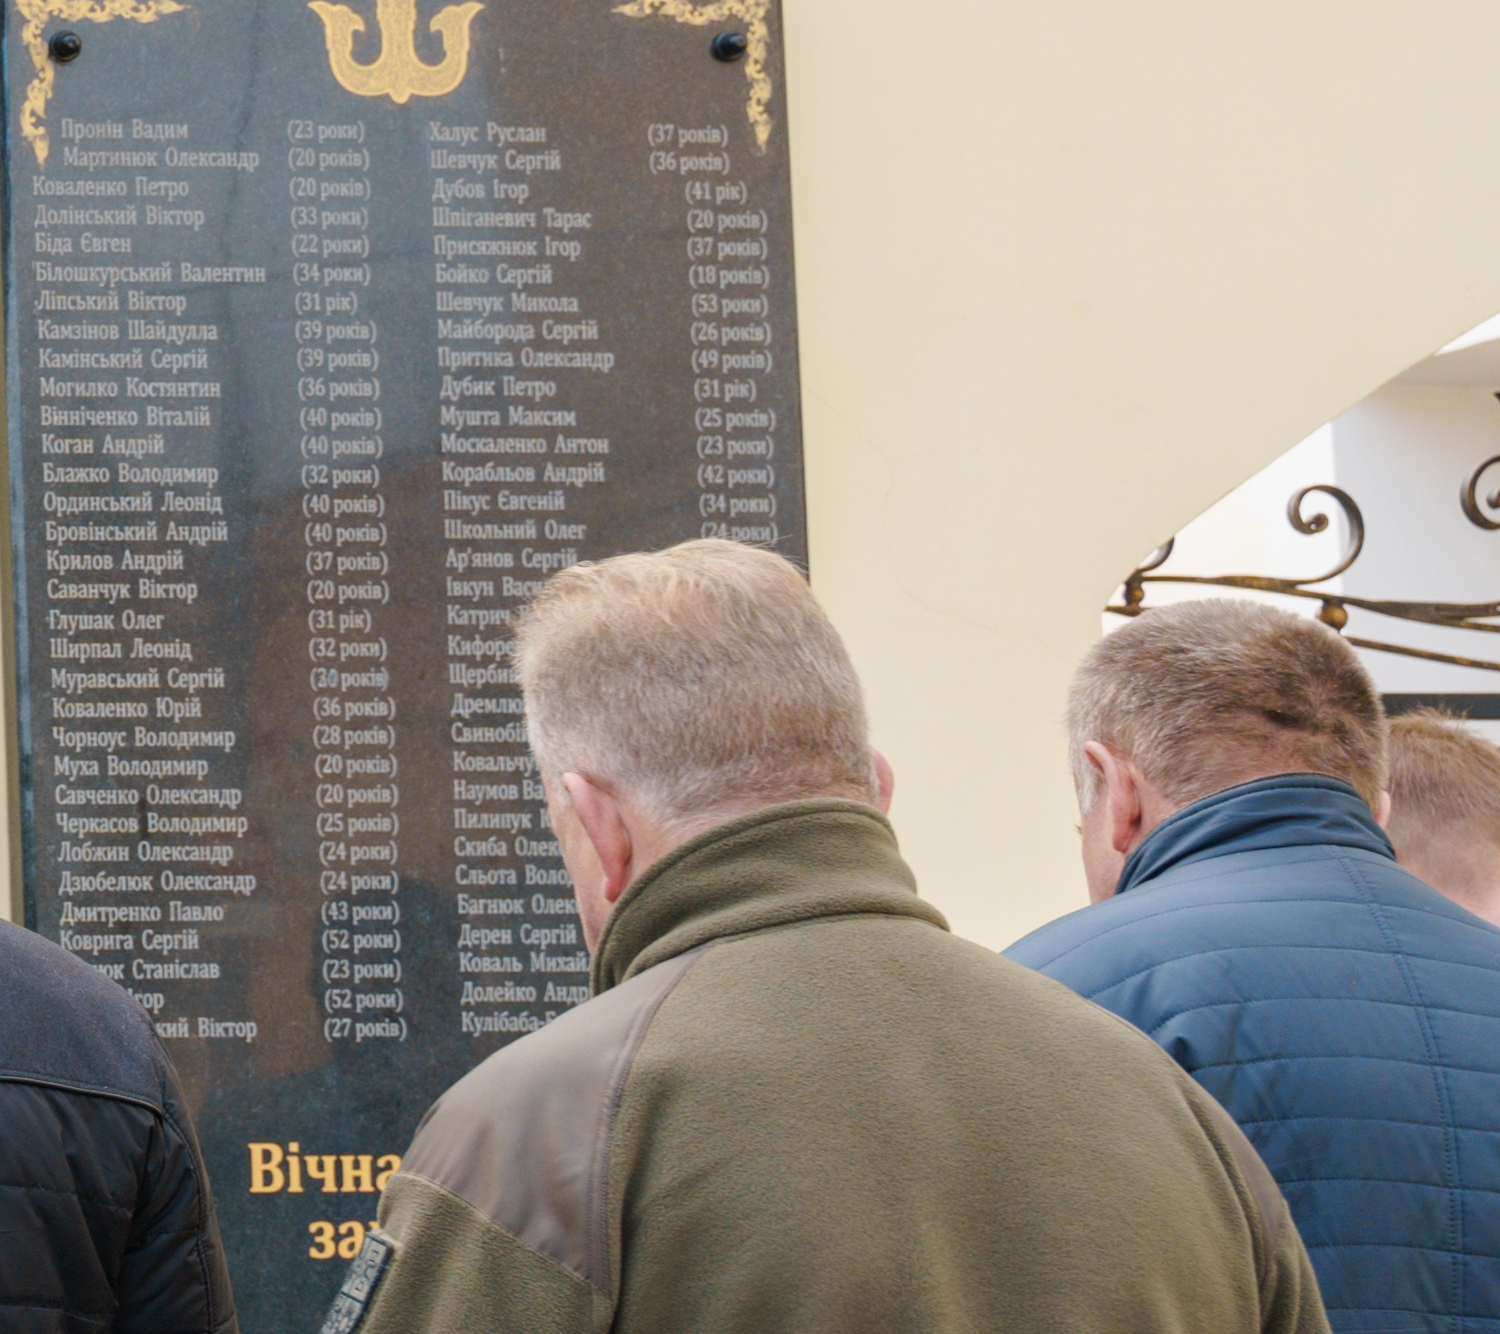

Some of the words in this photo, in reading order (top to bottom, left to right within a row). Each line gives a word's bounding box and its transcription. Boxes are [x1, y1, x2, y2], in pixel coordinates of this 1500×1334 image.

[435, 291, 502, 316] Шевчук
[511, 291, 578, 313] Микола
[690, 294, 718, 316] (53
[721, 294, 768, 317] роки)
[39, 377, 118, 400] Могилко
[126, 377, 220, 397] Костянтин
[298, 377, 325, 401] (36
[328, 377, 380, 401] років)
[40, 405, 137, 426] Вінніченко
[146, 405, 210, 426] Віталій
[300, 406, 327, 430] (40
[331, 406, 382, 431] років)
[42, 462, 109, 484] Блажко
[118, 463, 218, 486] Володимир
[301, 464, 328, 488] (32
[331, 464, 380, 488] роки)
[443, 490, 490, 515] Пікус
[498, 490, 564, 510] Євгеній
[700, 493, 726, 515] (34
[729, 493, 776, 516] роки)
[54, 754, 98, 780] Муха
[107, 754, 208, 779] Володимир
[314, 754, 342, 777] (20
[346, 754, 397, 777] років)
[59, 870, 152, 895] Дзюбелюк
[160, 870, 256, 895] Олександр
[319, 871, 347, 894] (24
[351, 871, 398, 895] роки)
[247, 1141, 402, 1193] Вічна
